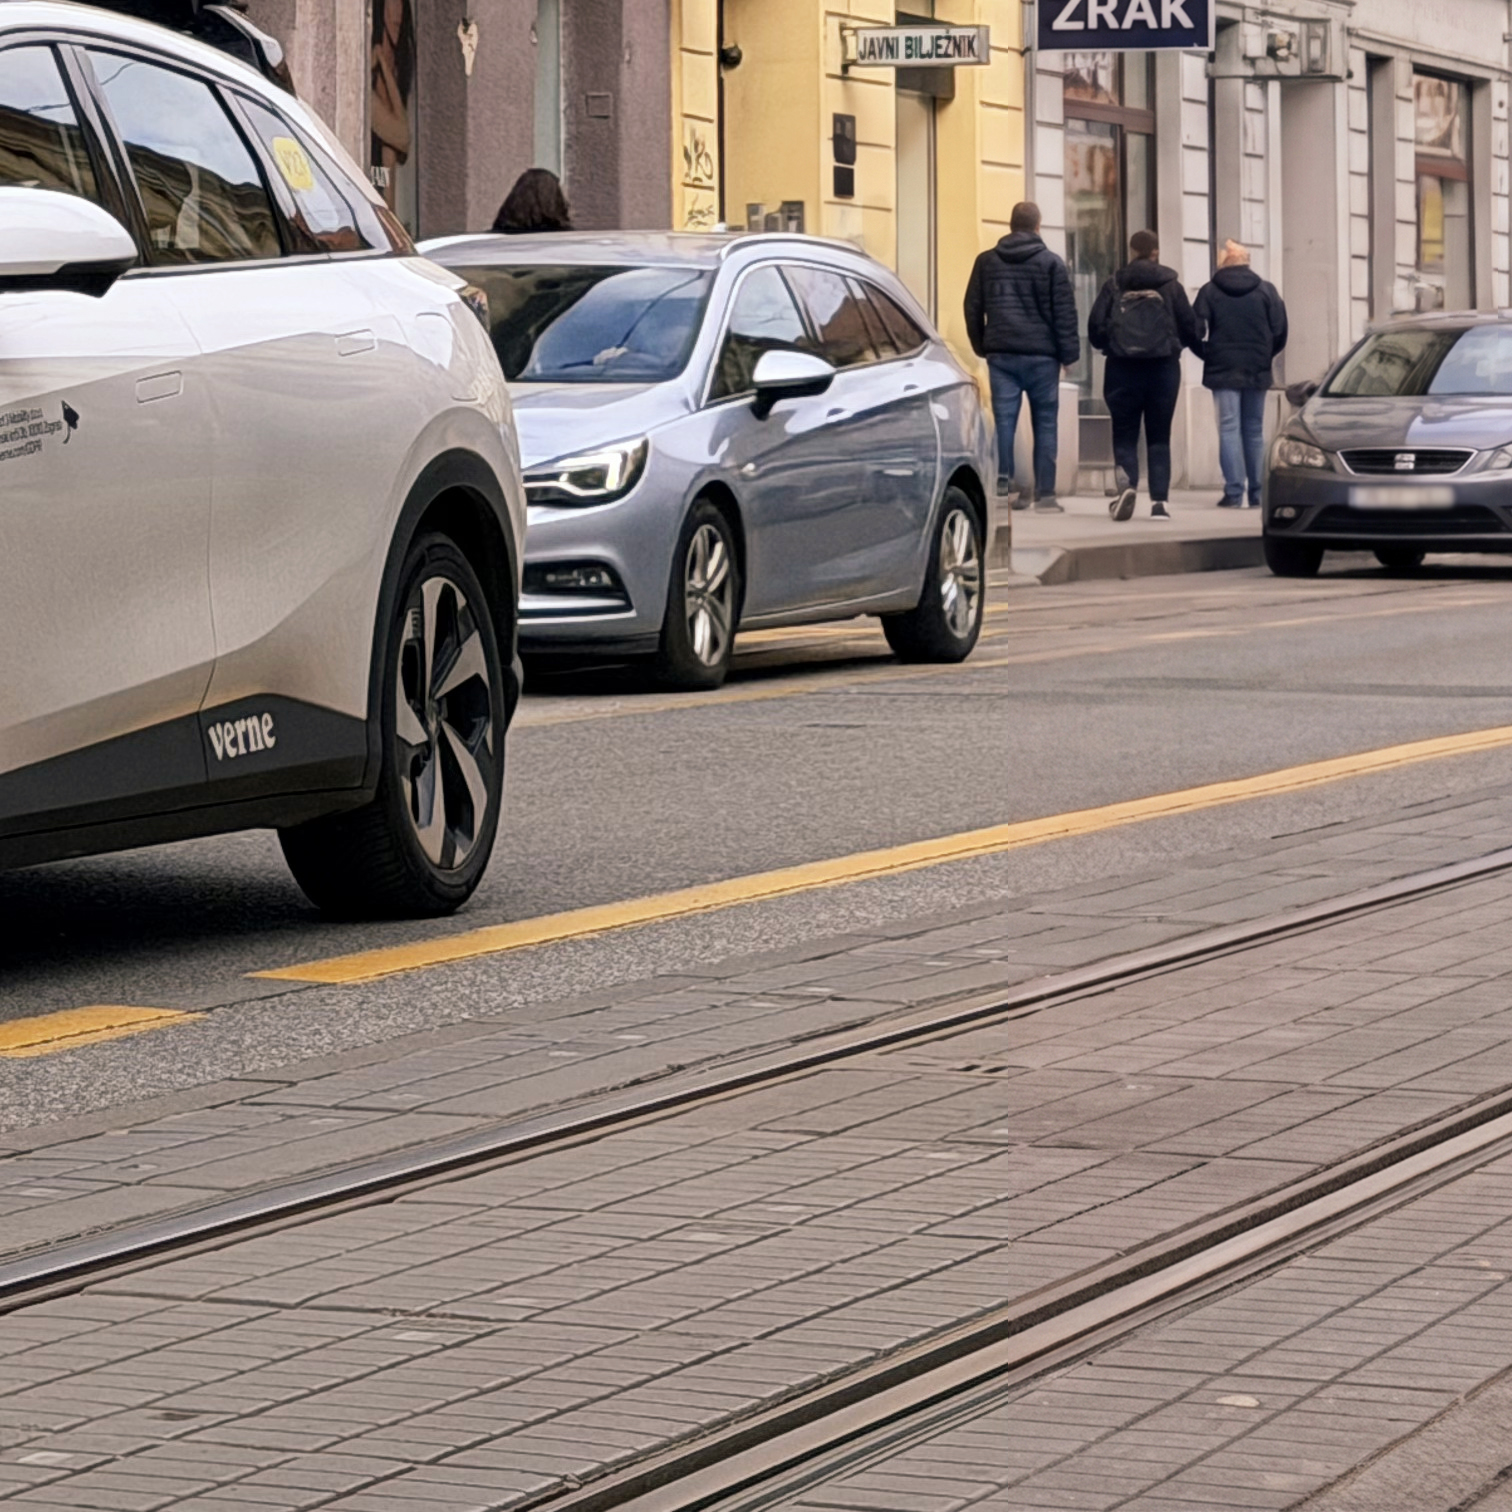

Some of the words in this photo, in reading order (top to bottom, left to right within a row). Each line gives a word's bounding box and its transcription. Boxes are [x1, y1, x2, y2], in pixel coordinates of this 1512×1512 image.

[858, 35, 900, 60] JAVNI
[904, 29, 977, 59] BILJEŽNIK
[208, 712, 276, 761] verne
